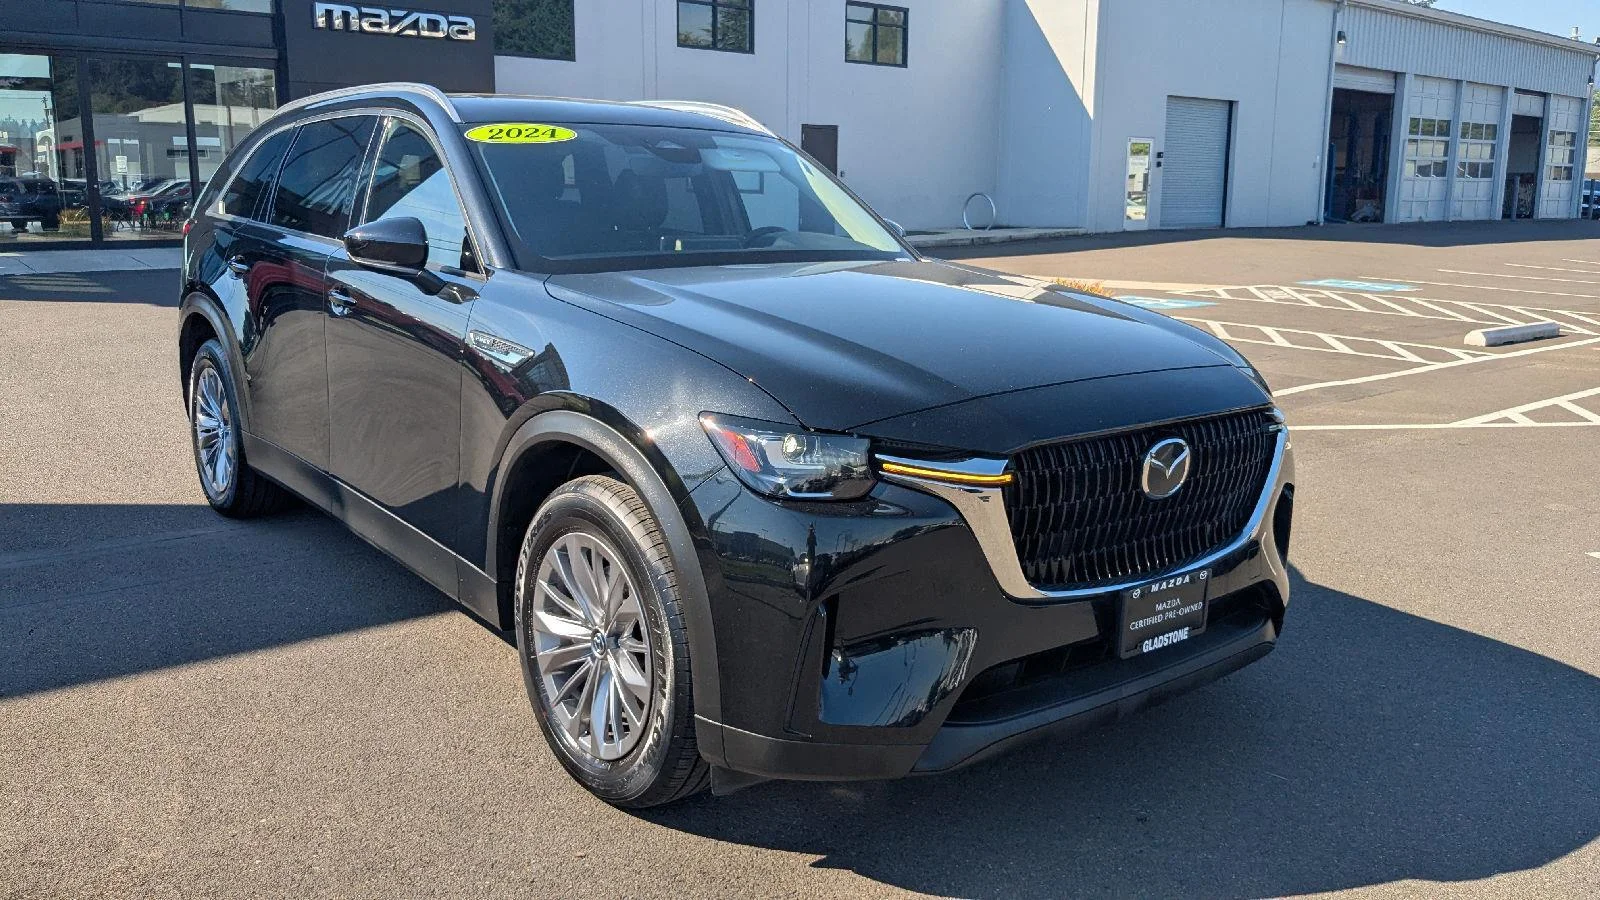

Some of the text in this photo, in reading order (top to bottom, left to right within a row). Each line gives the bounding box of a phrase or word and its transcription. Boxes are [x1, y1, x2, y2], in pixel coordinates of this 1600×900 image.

[487, 127, 558, 140] 2024
[1151, 574, 1190, 593] MAZDA
[1155, 598, 1181, 612] MAZDA
[1129, 601, 1203, 631] CERTIFIED PRE-OWNED
[1142, 626, 1189, 653] GLADSTONE
